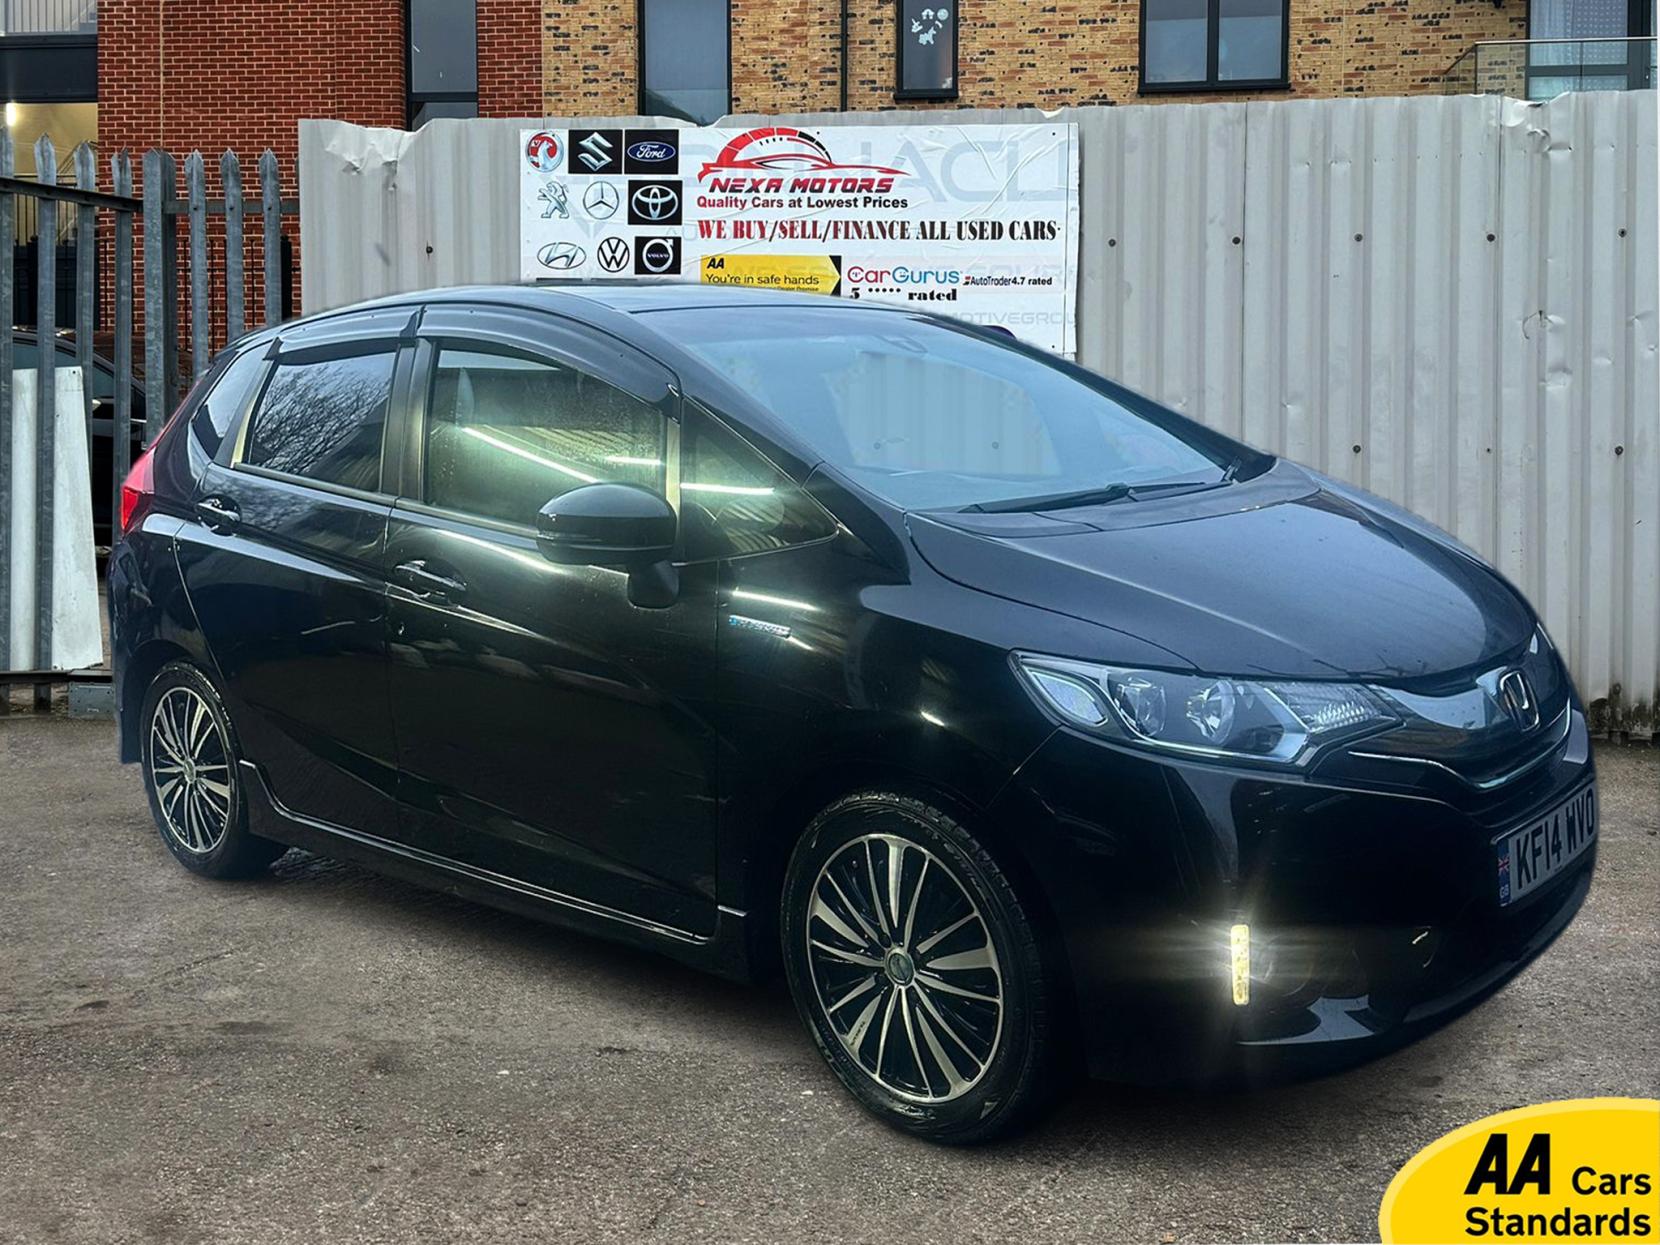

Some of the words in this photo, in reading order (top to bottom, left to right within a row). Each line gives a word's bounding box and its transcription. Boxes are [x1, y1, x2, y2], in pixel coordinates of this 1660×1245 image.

[636, 144, 666, 159] Ford
[708, 177, 784, 194] NEXA
[789, 177, 895, 194] MOTORS
[697, 196, 747, 210] Quality
[752, 196, 784, 209] Cars
[788, 197, 803, 209] at
[807, 196, 859, 209] Lowest
[863, 196, 909, 209] Prices
[698, 219, 727, 240] WE
[732, 219, 911, 243] BUY/SELL/FINANCE
[916, 220, 951, 241] ALL
[956, 220, 1004, 241] USED
[706, 257, 725, 270] AA
[706, 273, 741, 285] You're
[743, 274, 755, 285] in
[757, 273, 782, 285] safe
[784, 274, 820, 286] hands
[847, 266, 960, 284] CarGurus
[1027, 276, 1053, 286] rated
[849, 287, 861, 300] 5
[907, 288, 958, 301] rated
[1515, 813, 1563, 890] KF14
